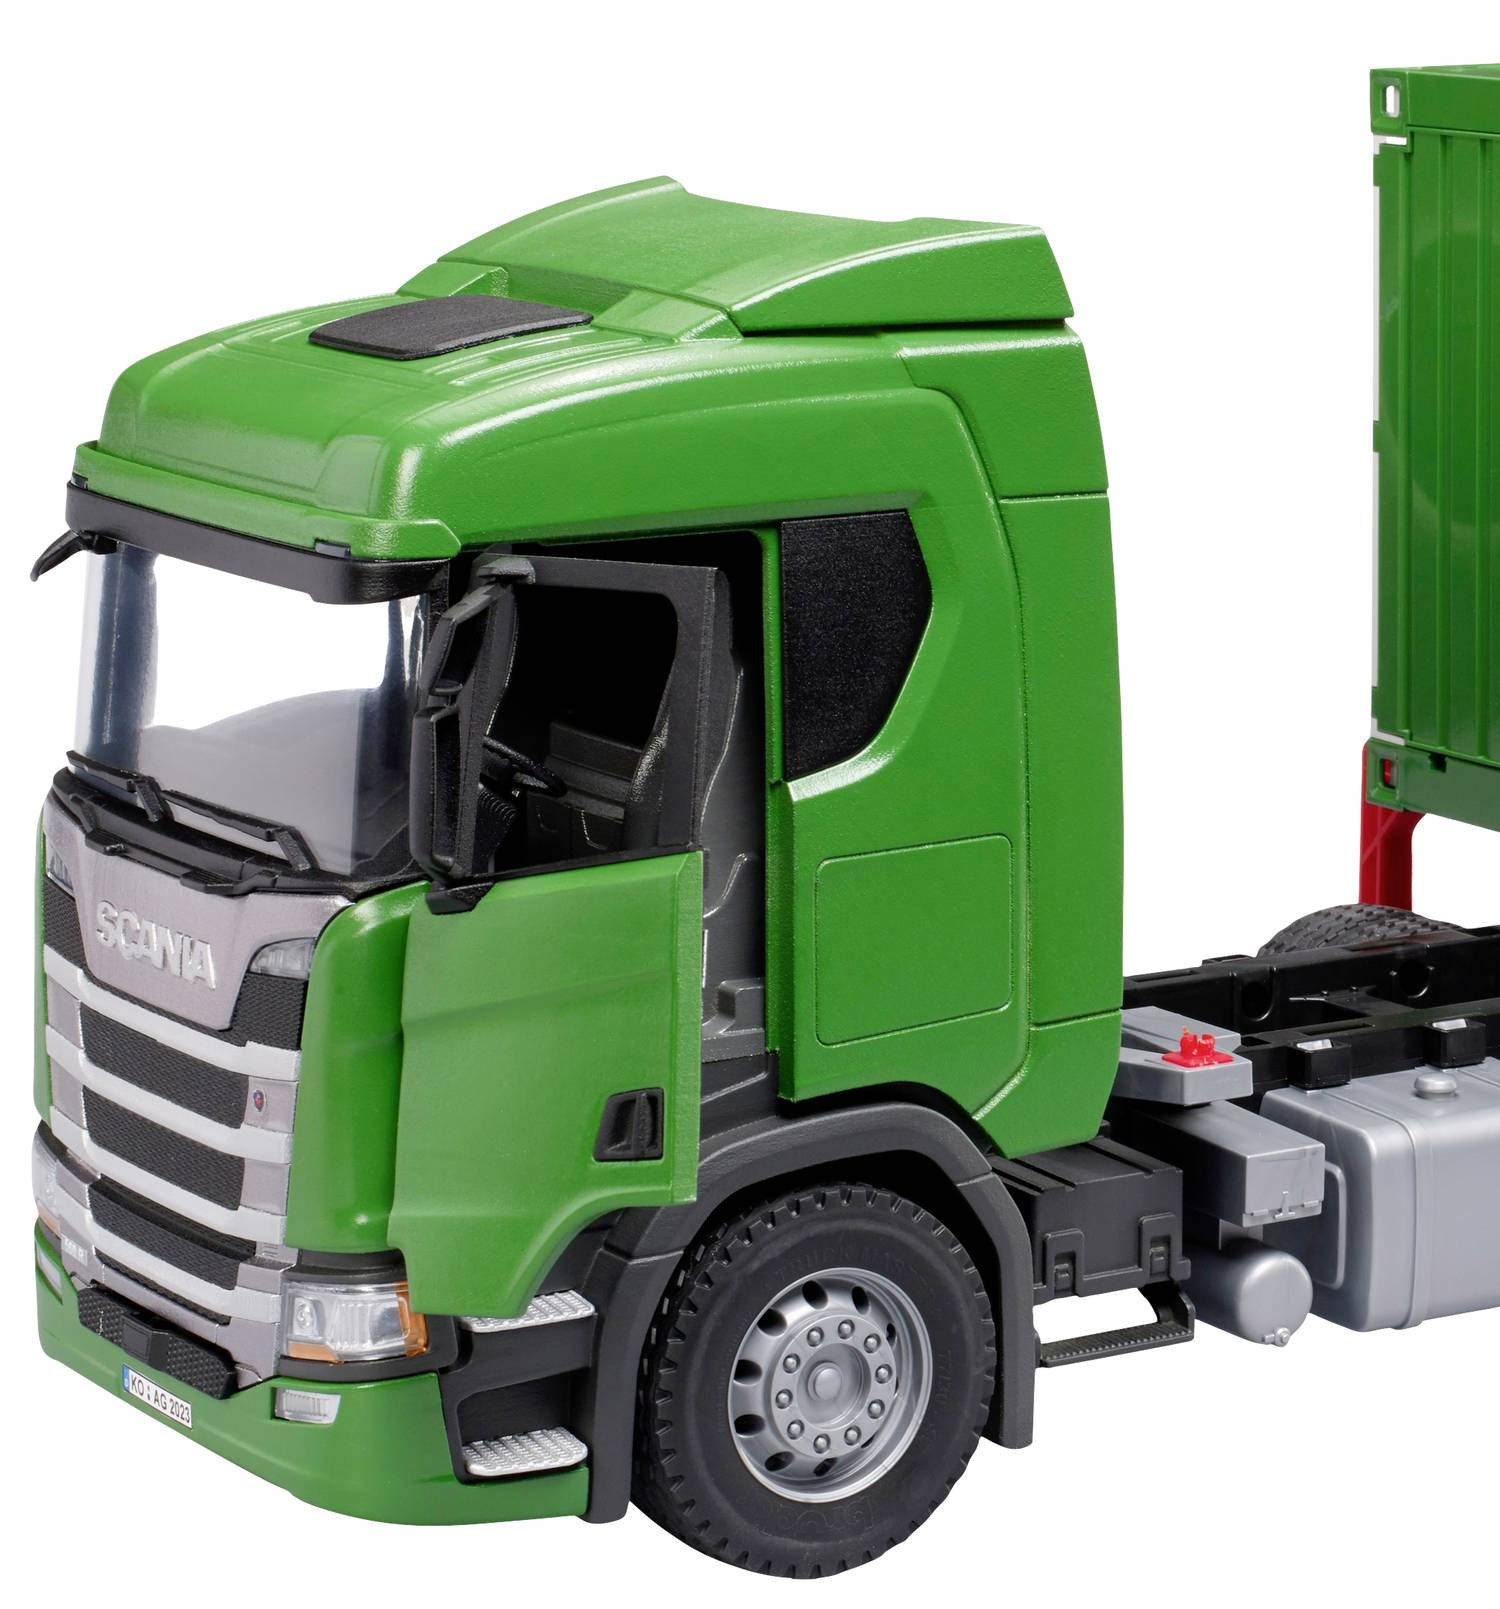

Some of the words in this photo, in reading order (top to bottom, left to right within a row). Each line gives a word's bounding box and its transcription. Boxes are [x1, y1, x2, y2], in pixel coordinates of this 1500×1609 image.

[95, 899, 216, 991] SCANIA
[130, 1373, 145, 1397] KO
[153, 1388, 168, 1411] AG
[169, 1397, 191, 1424] 2023
